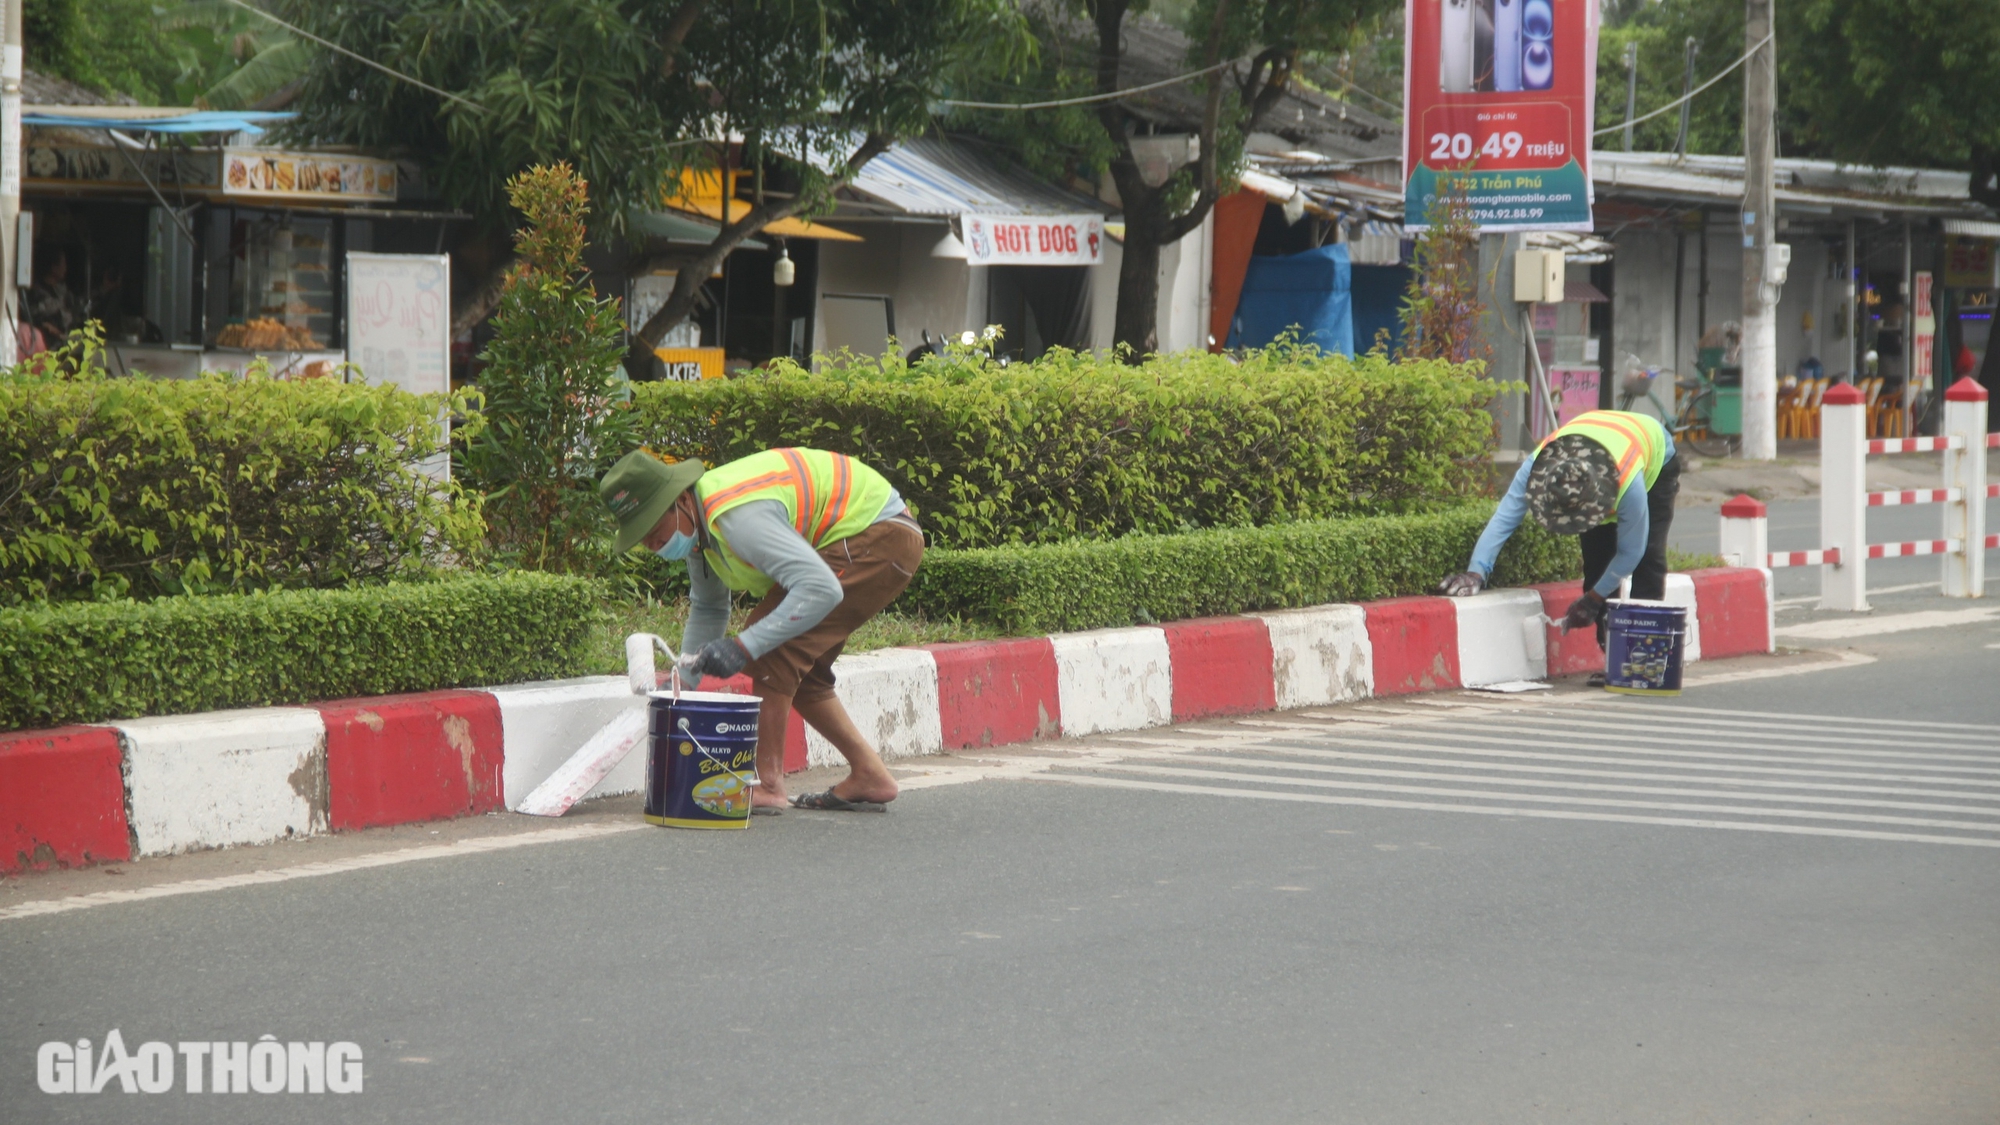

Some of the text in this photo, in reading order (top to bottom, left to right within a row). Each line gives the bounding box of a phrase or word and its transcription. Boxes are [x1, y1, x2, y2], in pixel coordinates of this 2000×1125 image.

[1477, 112, 1491, 121] Giá
[1430, 131, 1565, 160] 20.49 TRIỆU
[1482, 174, 1511, 189] Trần
[1516, 175, 1542, 188] Phú
[994, 224, 1078, 253] HOT DOG
[664, 362, 703, 381] LKTEA
[729, 724, 750, 732] NACO
